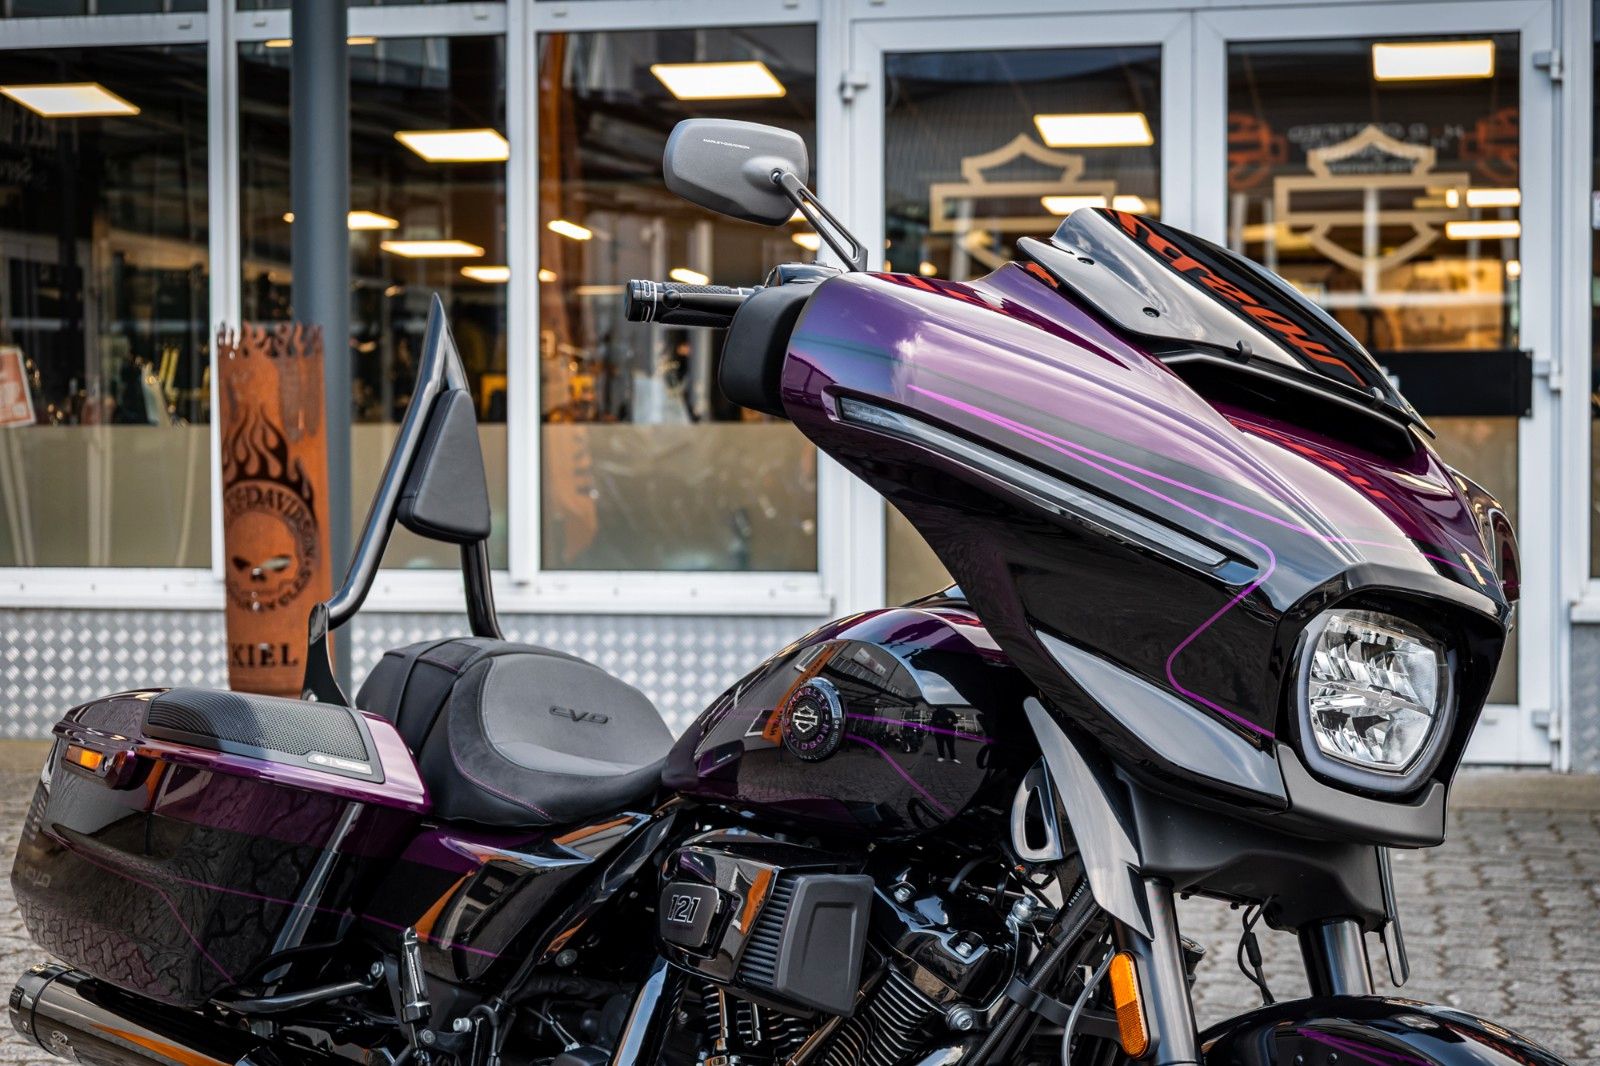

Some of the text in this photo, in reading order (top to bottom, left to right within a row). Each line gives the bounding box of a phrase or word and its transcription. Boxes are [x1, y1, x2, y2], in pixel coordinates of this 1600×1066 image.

[231, 642, 298, 668] KIEL
[549, 705, 609, 725] CVO
[667, 894, 702, 924] 121
